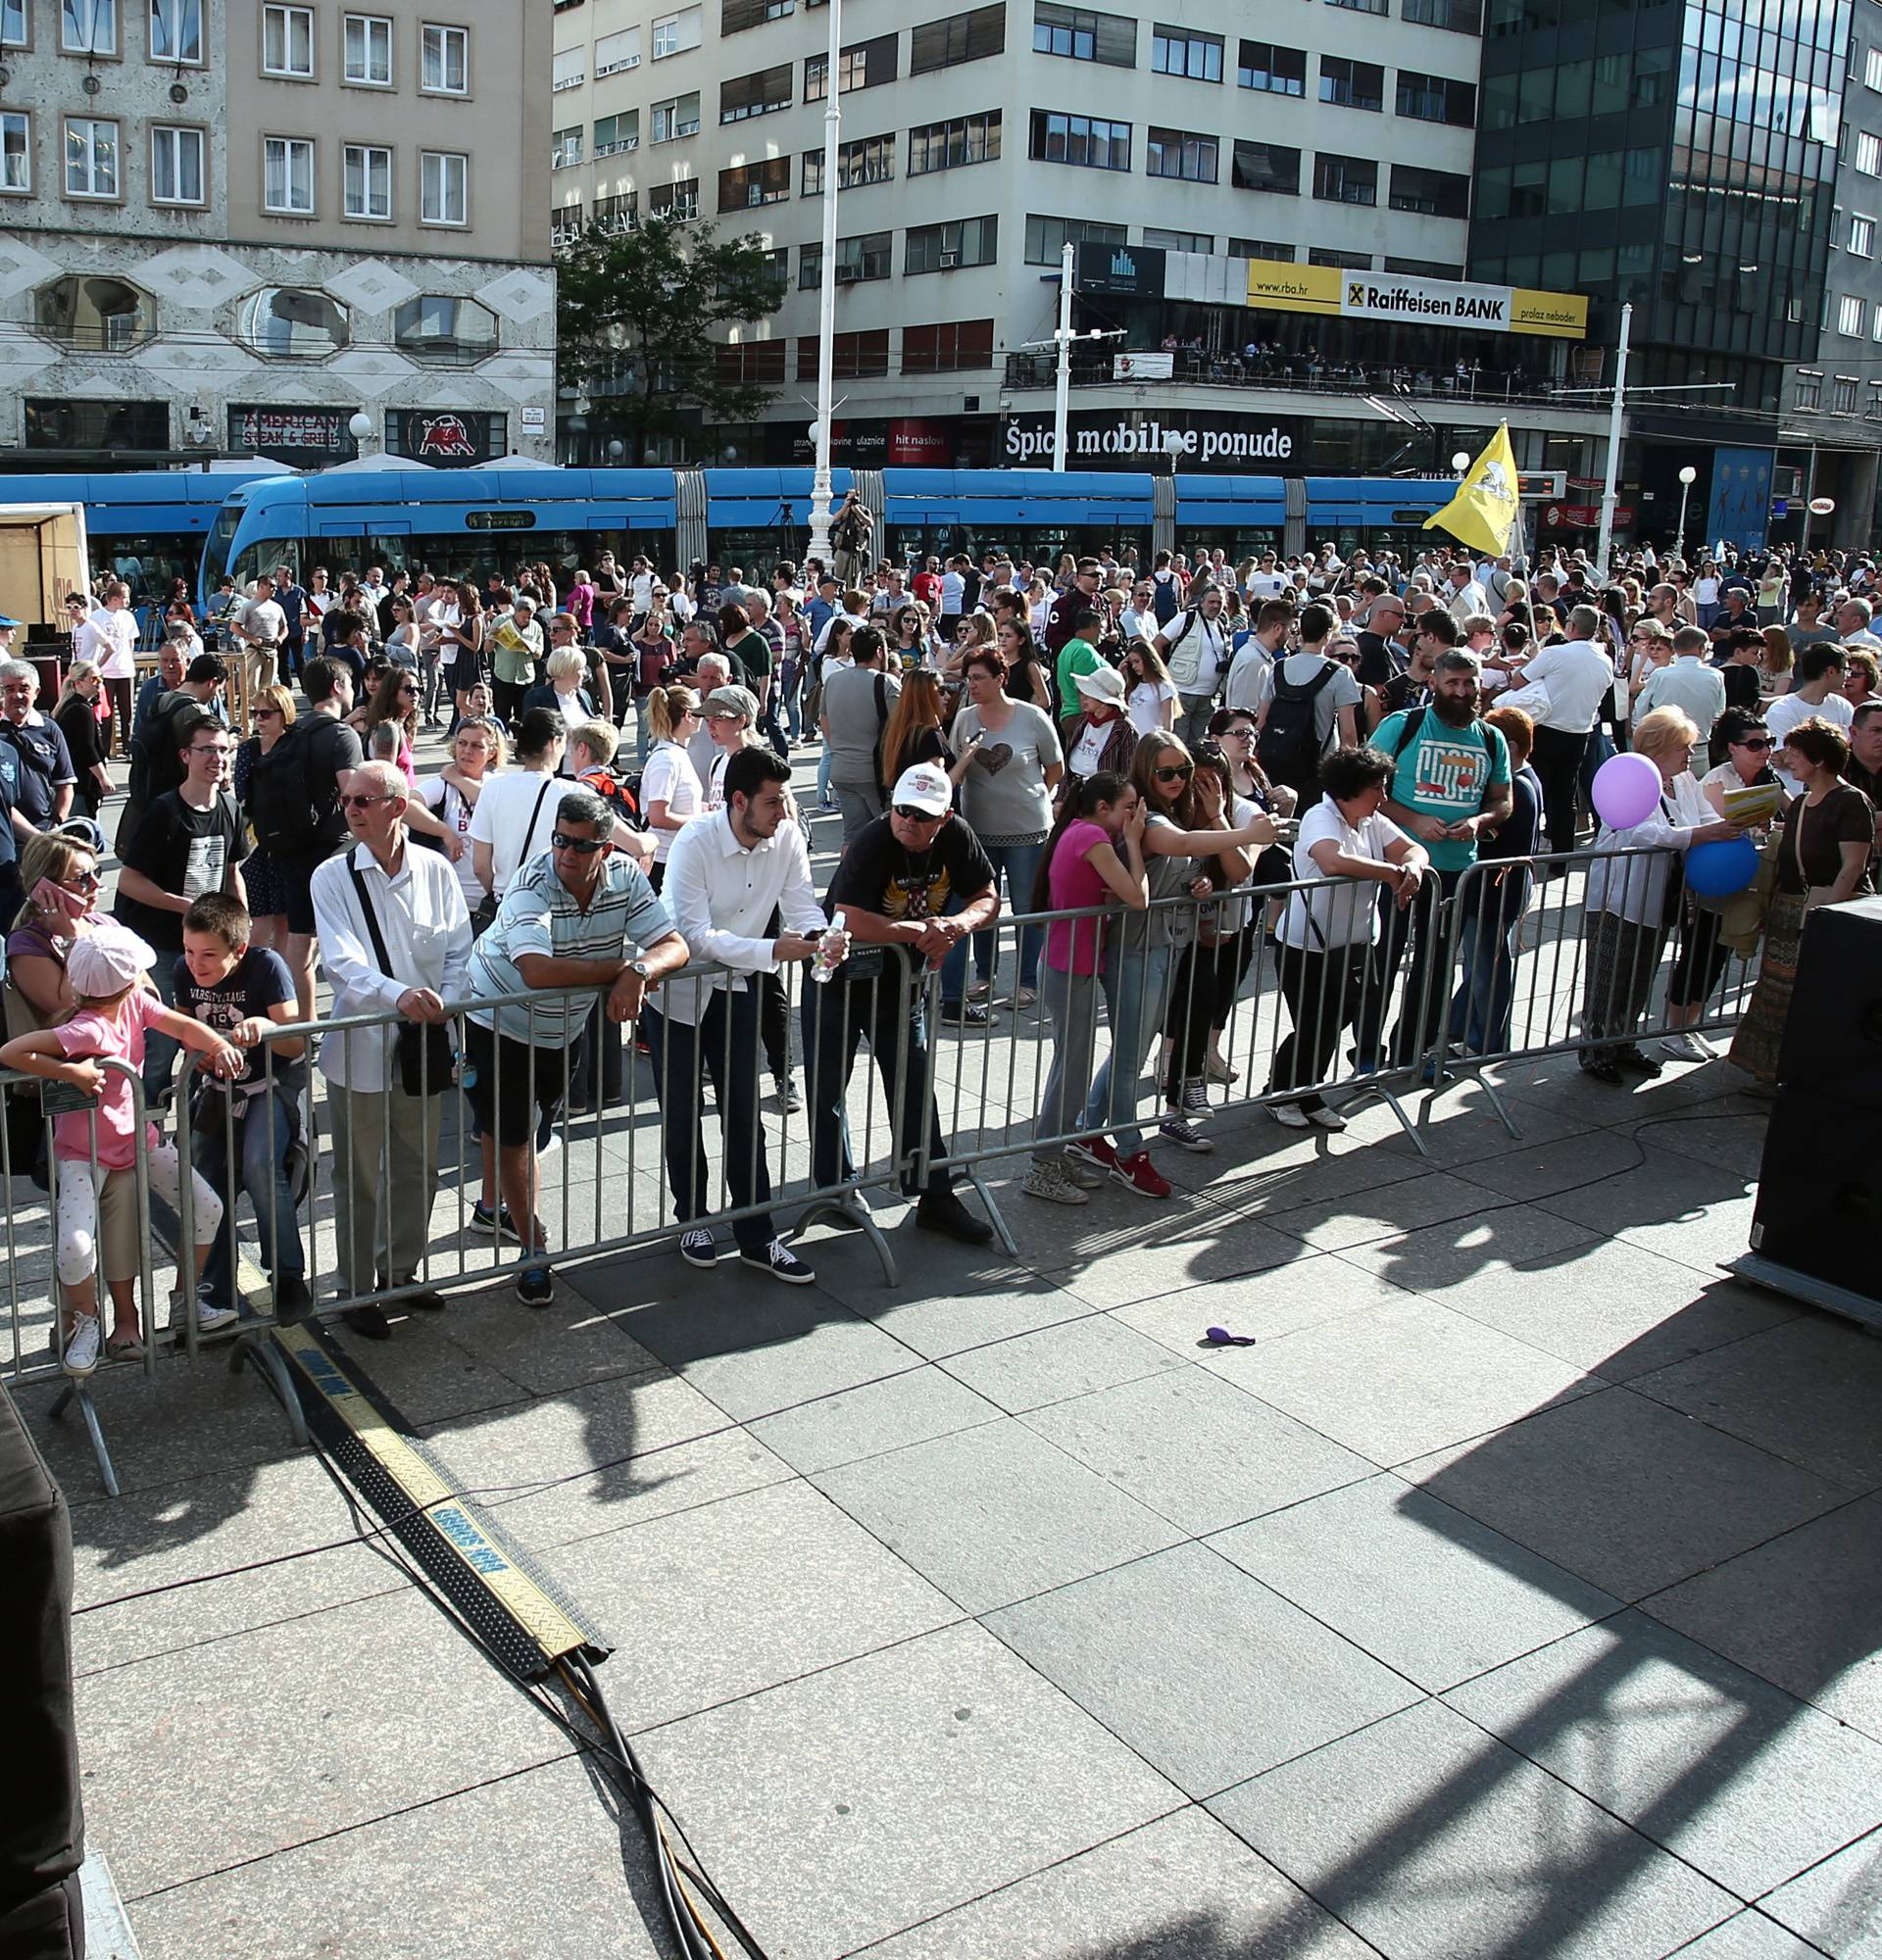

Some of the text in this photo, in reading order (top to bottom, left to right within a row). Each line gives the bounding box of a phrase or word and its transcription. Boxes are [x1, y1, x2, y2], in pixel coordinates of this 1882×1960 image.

[1257, 281, 1309, 295] www.rba.hr
[1367, 287, 1504, 320] Raiffeisen BANK
[1520, 309, 1576, 323] prolaz neboder
[243, 412, 339, 429] AMERICAN
[243, 430, 339, 445] STEAK & GRILL
[857, 434, 885, 446] ulaznice
[896, 434, 944, 446] hit naslovi
[1006, 418, 1069, 462] Špic
[1201, 427, 1292, 462] ponude
[190, 987, 223, 1003] VARSITY
